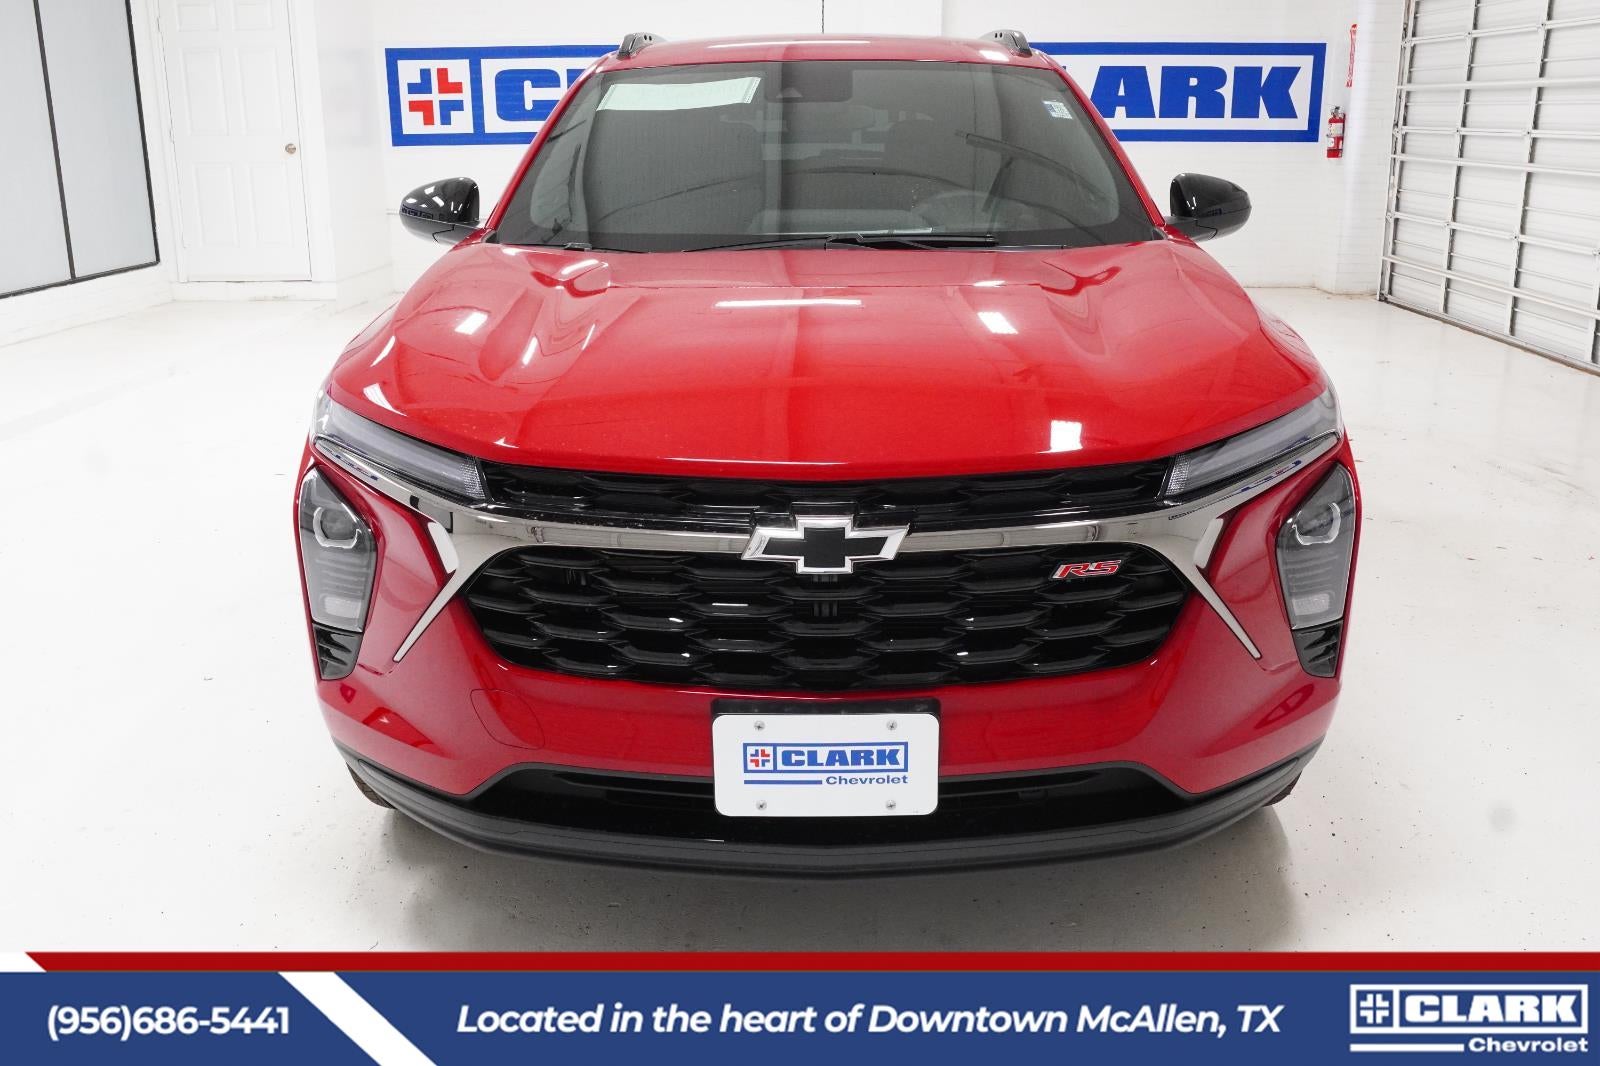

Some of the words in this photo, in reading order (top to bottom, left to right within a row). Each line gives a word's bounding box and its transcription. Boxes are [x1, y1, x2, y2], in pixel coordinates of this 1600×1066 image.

[1063, 65, 1301, 120] ARK
[1052, 559, 1121, 579] RS
[781, 748, 900, 767] CLARK
[825, 774, 909, 786] Chevrolet
